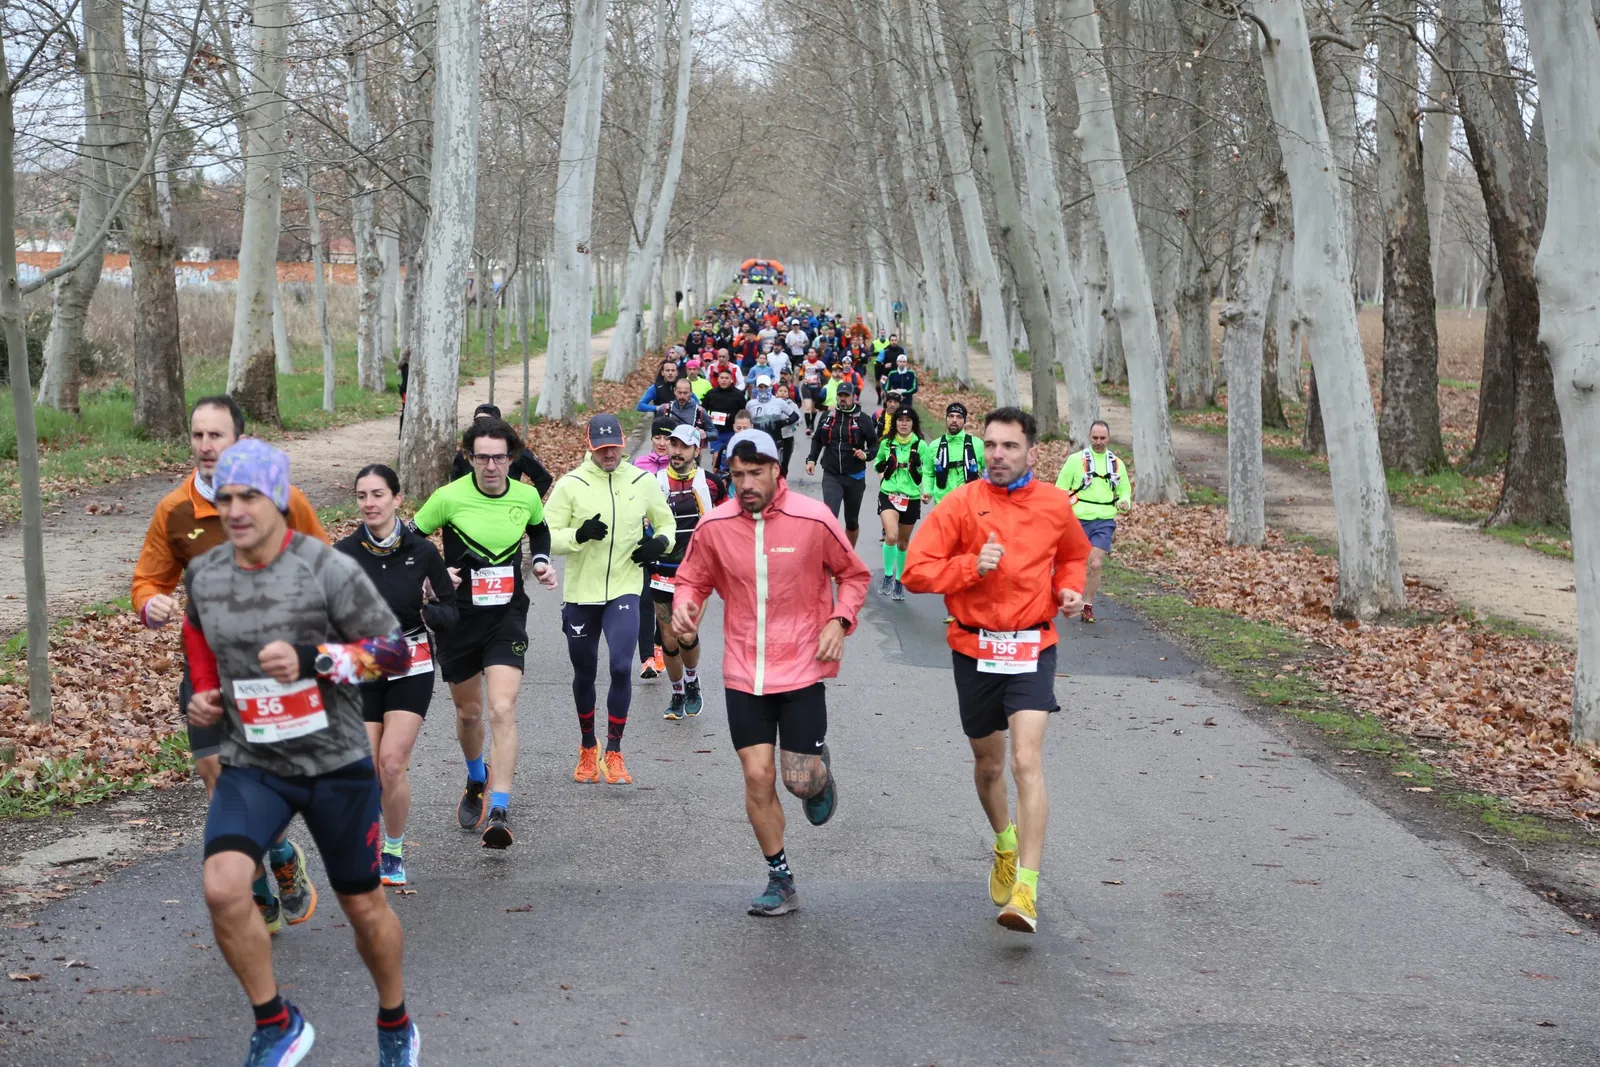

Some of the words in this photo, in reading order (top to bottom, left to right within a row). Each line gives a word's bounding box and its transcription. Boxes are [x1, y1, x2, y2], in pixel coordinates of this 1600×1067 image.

[485, 578, 502, 589] 72
[990, 642, 1017, 655] 196
[256, 697, 284, 716] 56
